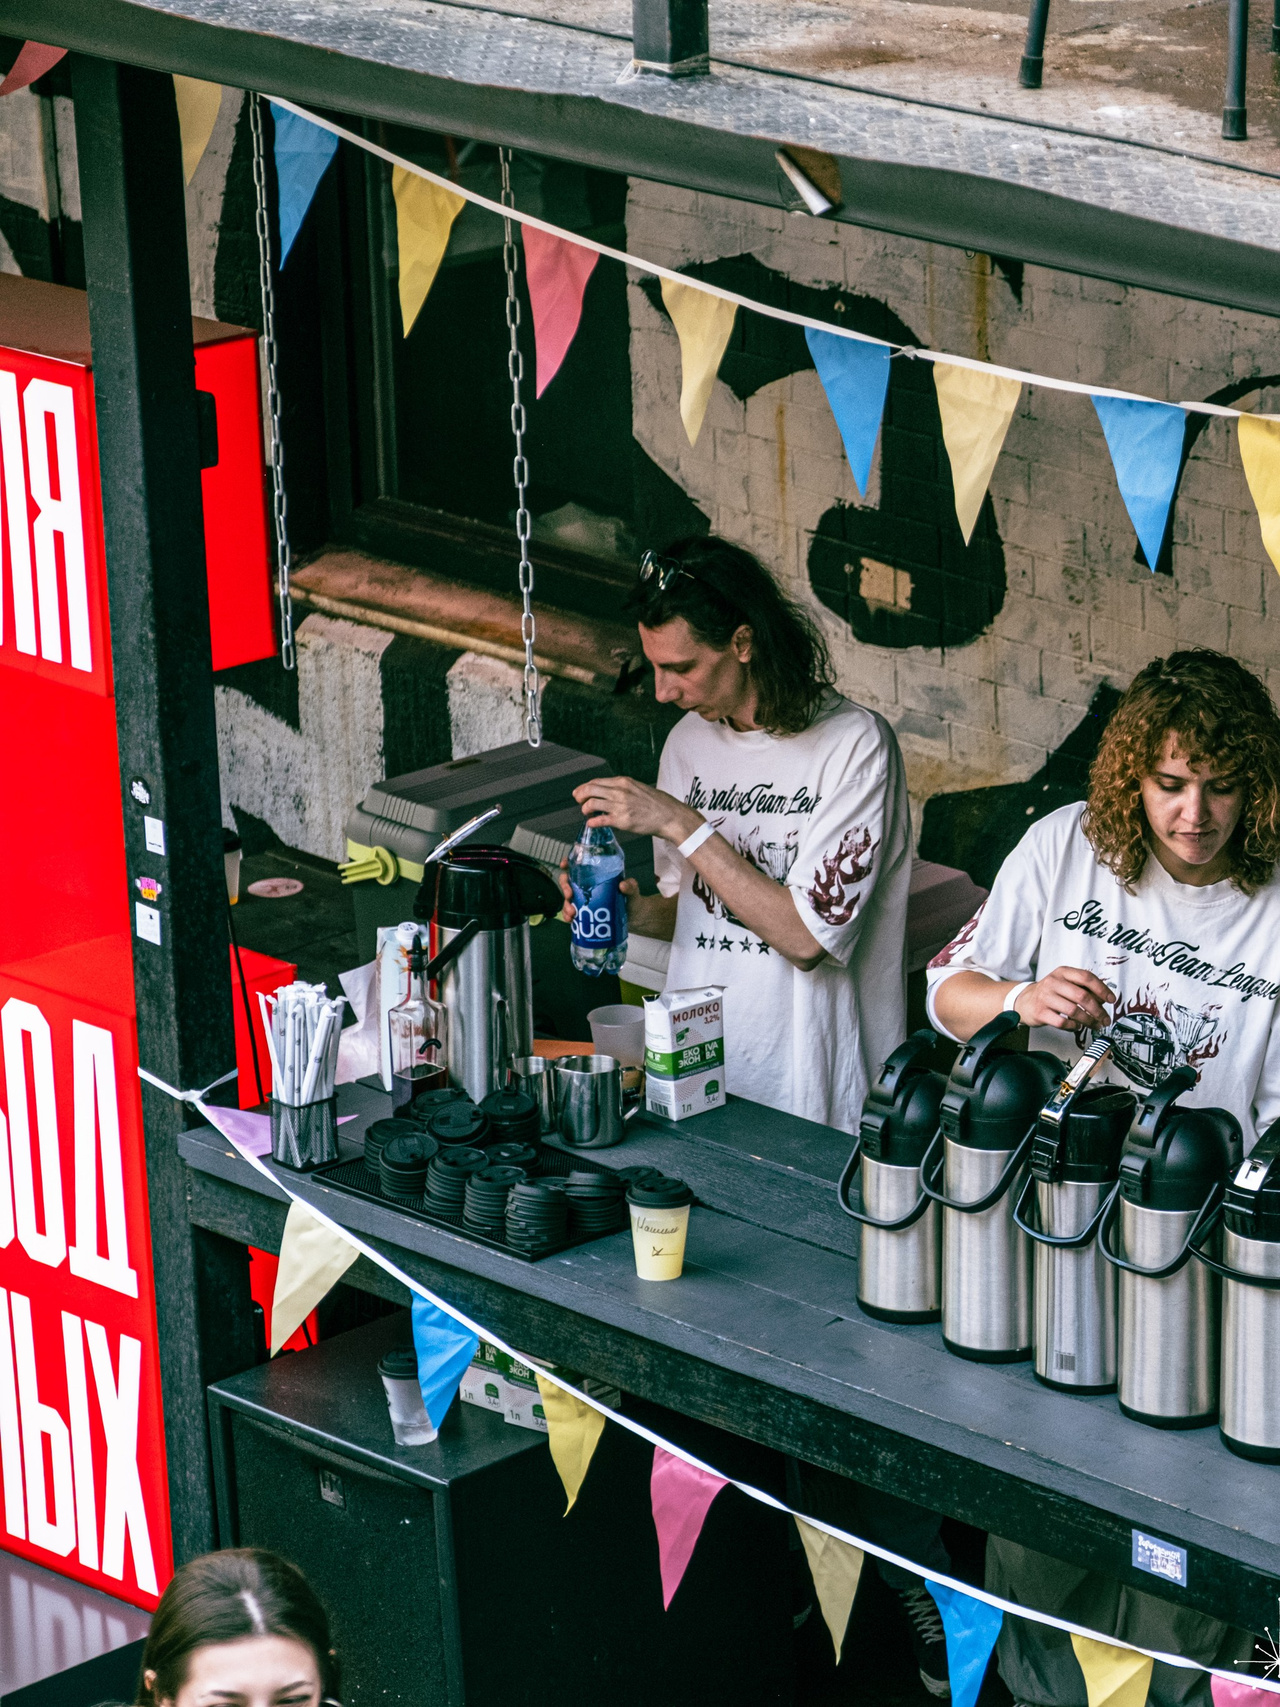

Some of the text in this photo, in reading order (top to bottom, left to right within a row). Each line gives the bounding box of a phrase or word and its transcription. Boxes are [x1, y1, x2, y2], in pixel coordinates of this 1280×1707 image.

[1153, 941, 1216, 982] Team
[1207, 962, 1280, 1003] League
[672, 1002, 720, 1025] МОЛОКО
